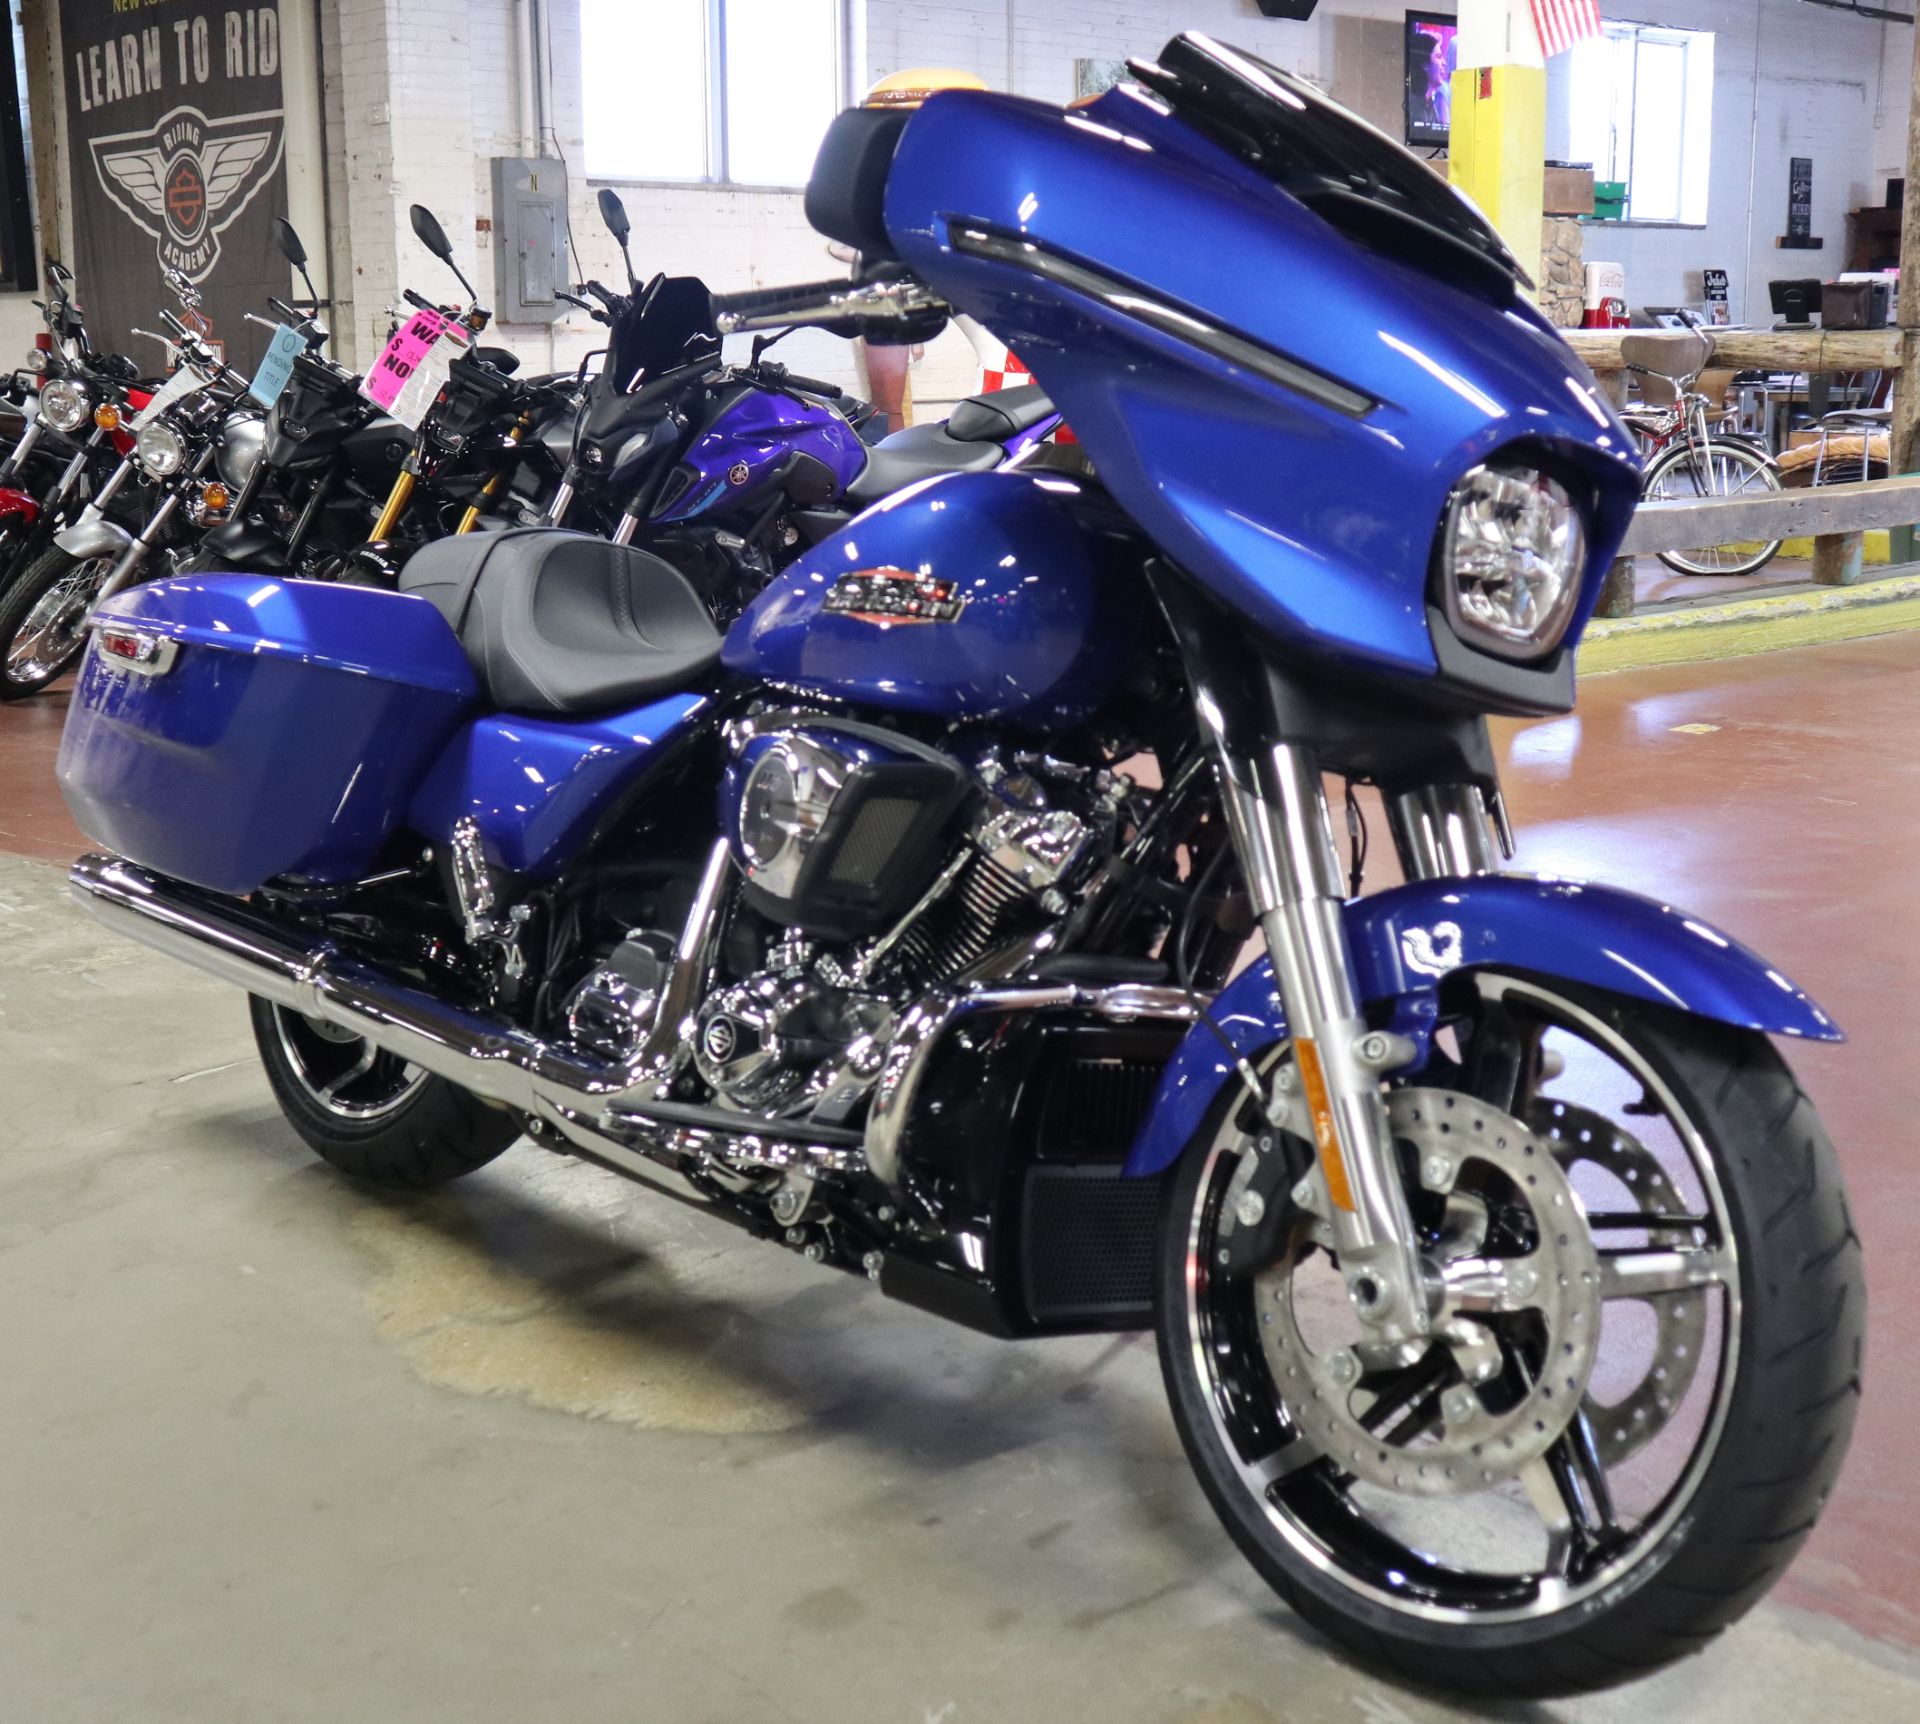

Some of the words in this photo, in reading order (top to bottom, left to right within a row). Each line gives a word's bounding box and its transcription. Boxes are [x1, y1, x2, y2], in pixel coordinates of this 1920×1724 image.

[113, 0, 139, 13] NEW
[76, 26, 162, 112] LEARN
[174, 16, 209, 85] TO
[225, 8, 278, 79] RID
[163, 122, 199, 151] RIDING
[164, 237, 211, 271] ACADEMY
[411, 321, 441, 345] WA
[267, 351, 293, 374] PENDING
[383, 353, 415, 379] NO
[264, 371, 280, 387] TITLE
